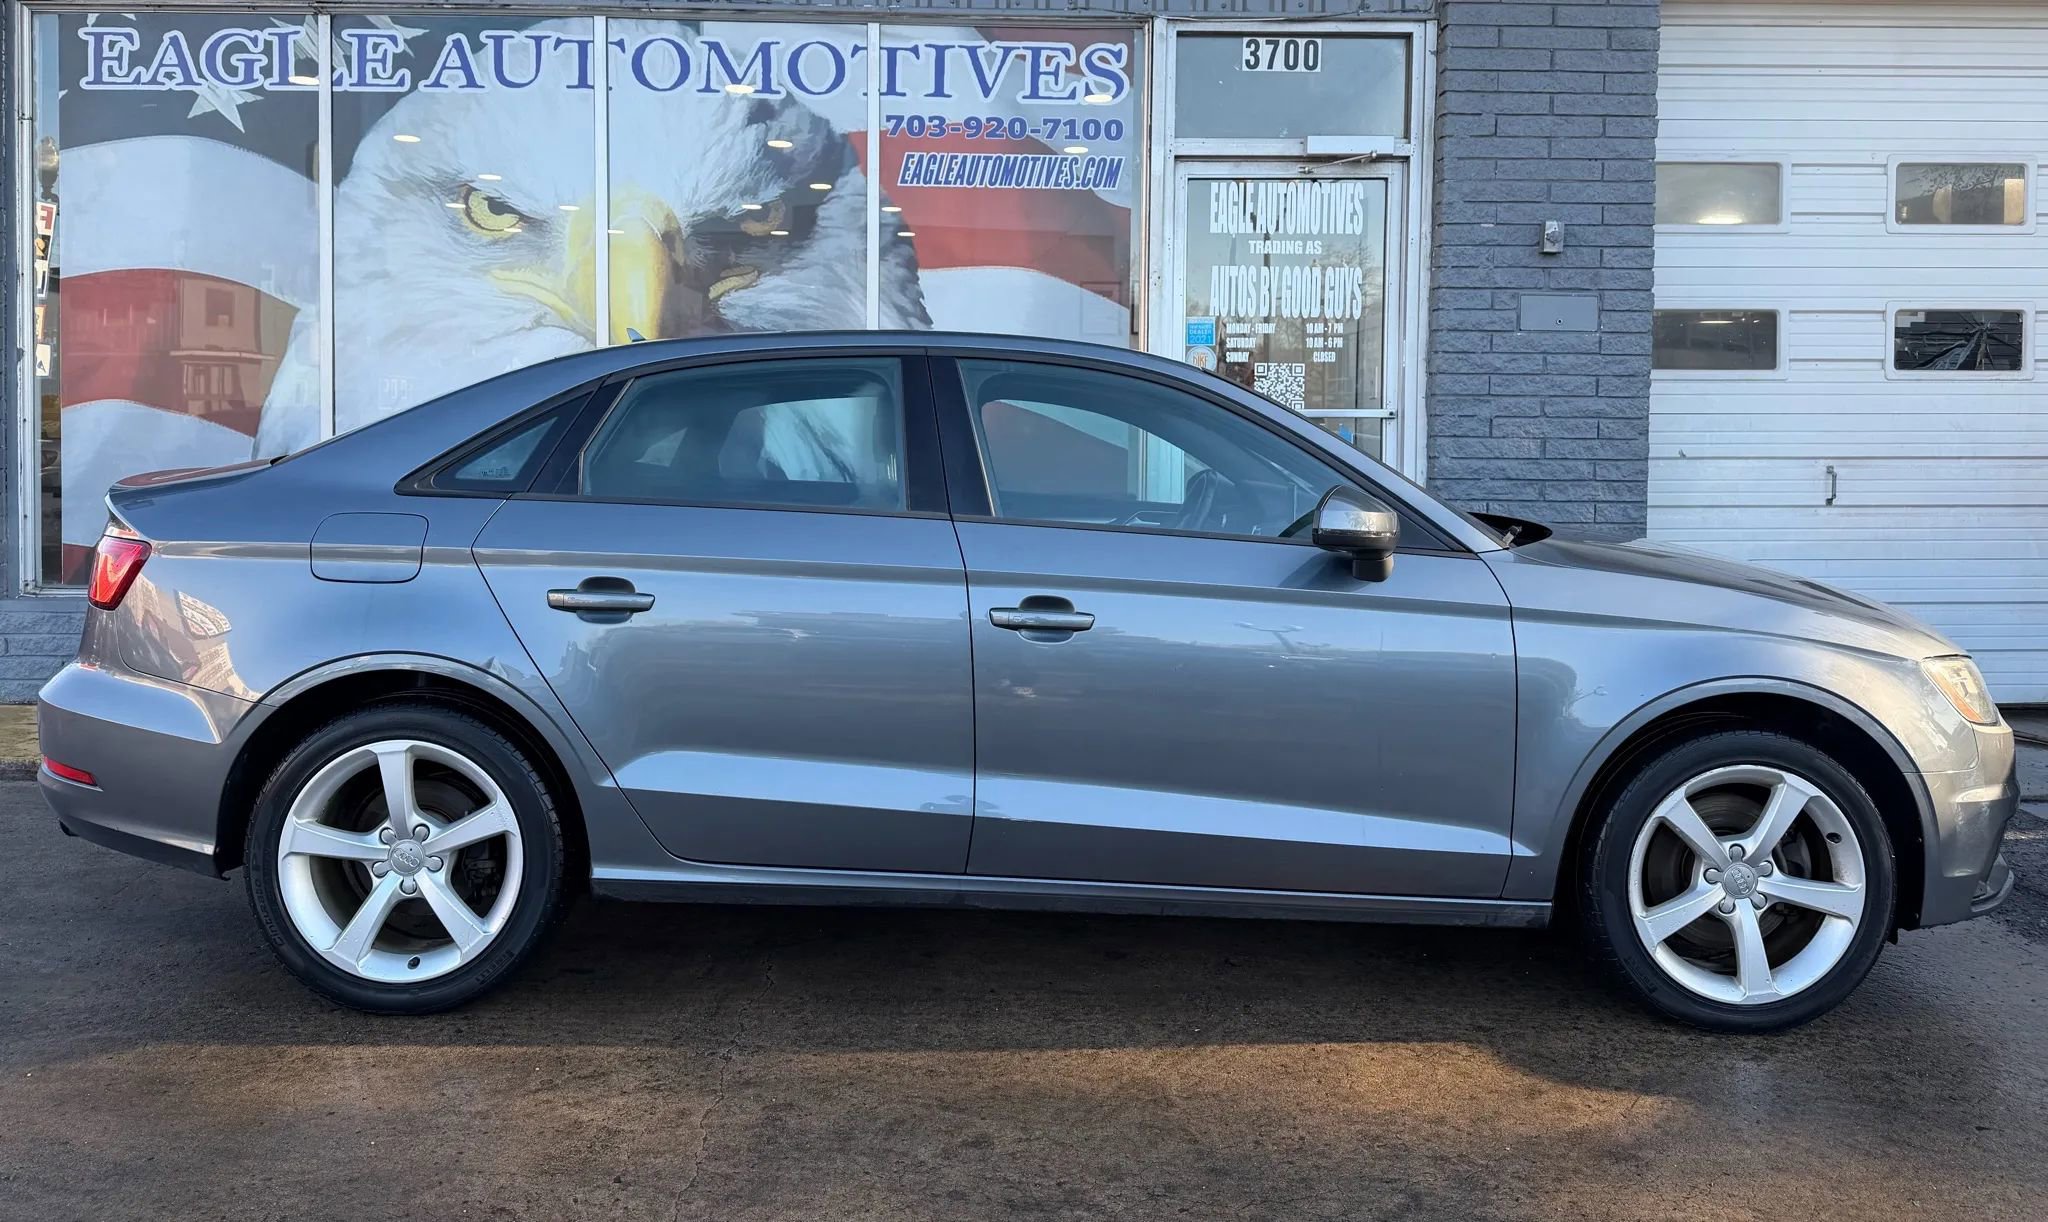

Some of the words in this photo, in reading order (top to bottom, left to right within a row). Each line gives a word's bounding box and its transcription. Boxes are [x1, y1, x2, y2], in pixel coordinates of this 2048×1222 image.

[1244, 38, 1320, 71] 3700
[81, 28, 409, 91] EAGLE
[421, 32, 1131, 102] AUTOMOTIVES
[884, 114, 1125, 142] 703-920-7100
[898, 152, 1124, 190] EAGLEAUTOMOTIVES.COM
[1209, 181, 1255, 237] EAGLE
[1256, 181, 1364, 236] AUTOMOTIVES
[1248, 240, 1303, 255] TRADING
[1305, 240, 1323, 255] AS
[1209, 264, 1257, 318] AUTOS
[1259, 265, 1280, 318] BY
[1281, 265, 1322, 319] GOOD
[1324, 266, 1363, 320] GUYS
[1226, 322, 1251, 334] MONDAY
[1255, 322, 1276, 334] FRIDAY
[1306, 323, 1313, 334] 10
[1313, 323, 1324, 334] AM
[1333, 323, 1344, 334] PM
[1226, 337, 1256, 348] SATURDAY
[1306, 337, 1313, 348] 10
[1313, 337, 1324, 348] AM
[1333, 337, 1343, 348] PM
[1225, 351, 1249, 363] SUNDAY
[1313, 351, 1336, 363] CLOSED
